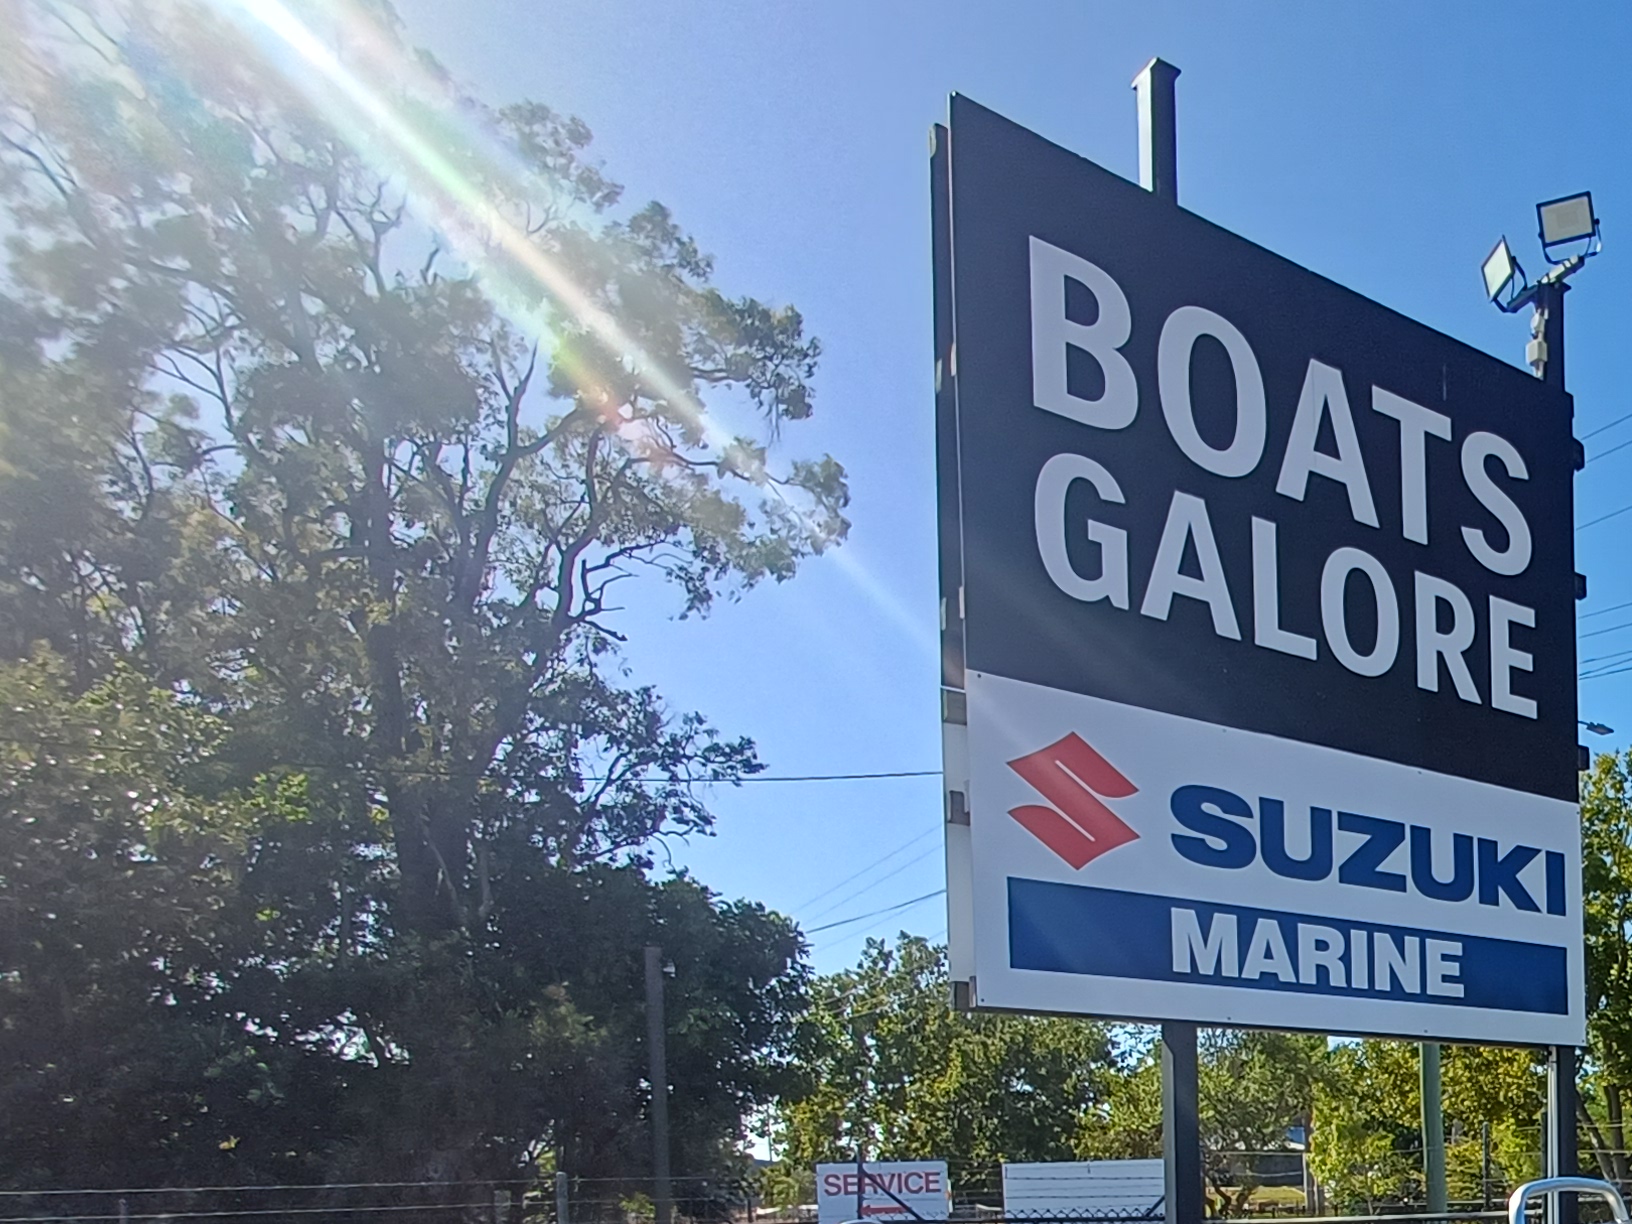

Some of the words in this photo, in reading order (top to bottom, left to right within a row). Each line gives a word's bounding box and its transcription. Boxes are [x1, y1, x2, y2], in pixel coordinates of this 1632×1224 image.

[1029, 235, 1533, 577] BOATS
[1033, 452, 1538, 720] GALORE
[1169, 784, 1567, 917] SUZUKI
[1169, 907, 1465, 998] MARINE
[823, 1171, 942, 1197] SERVICE
